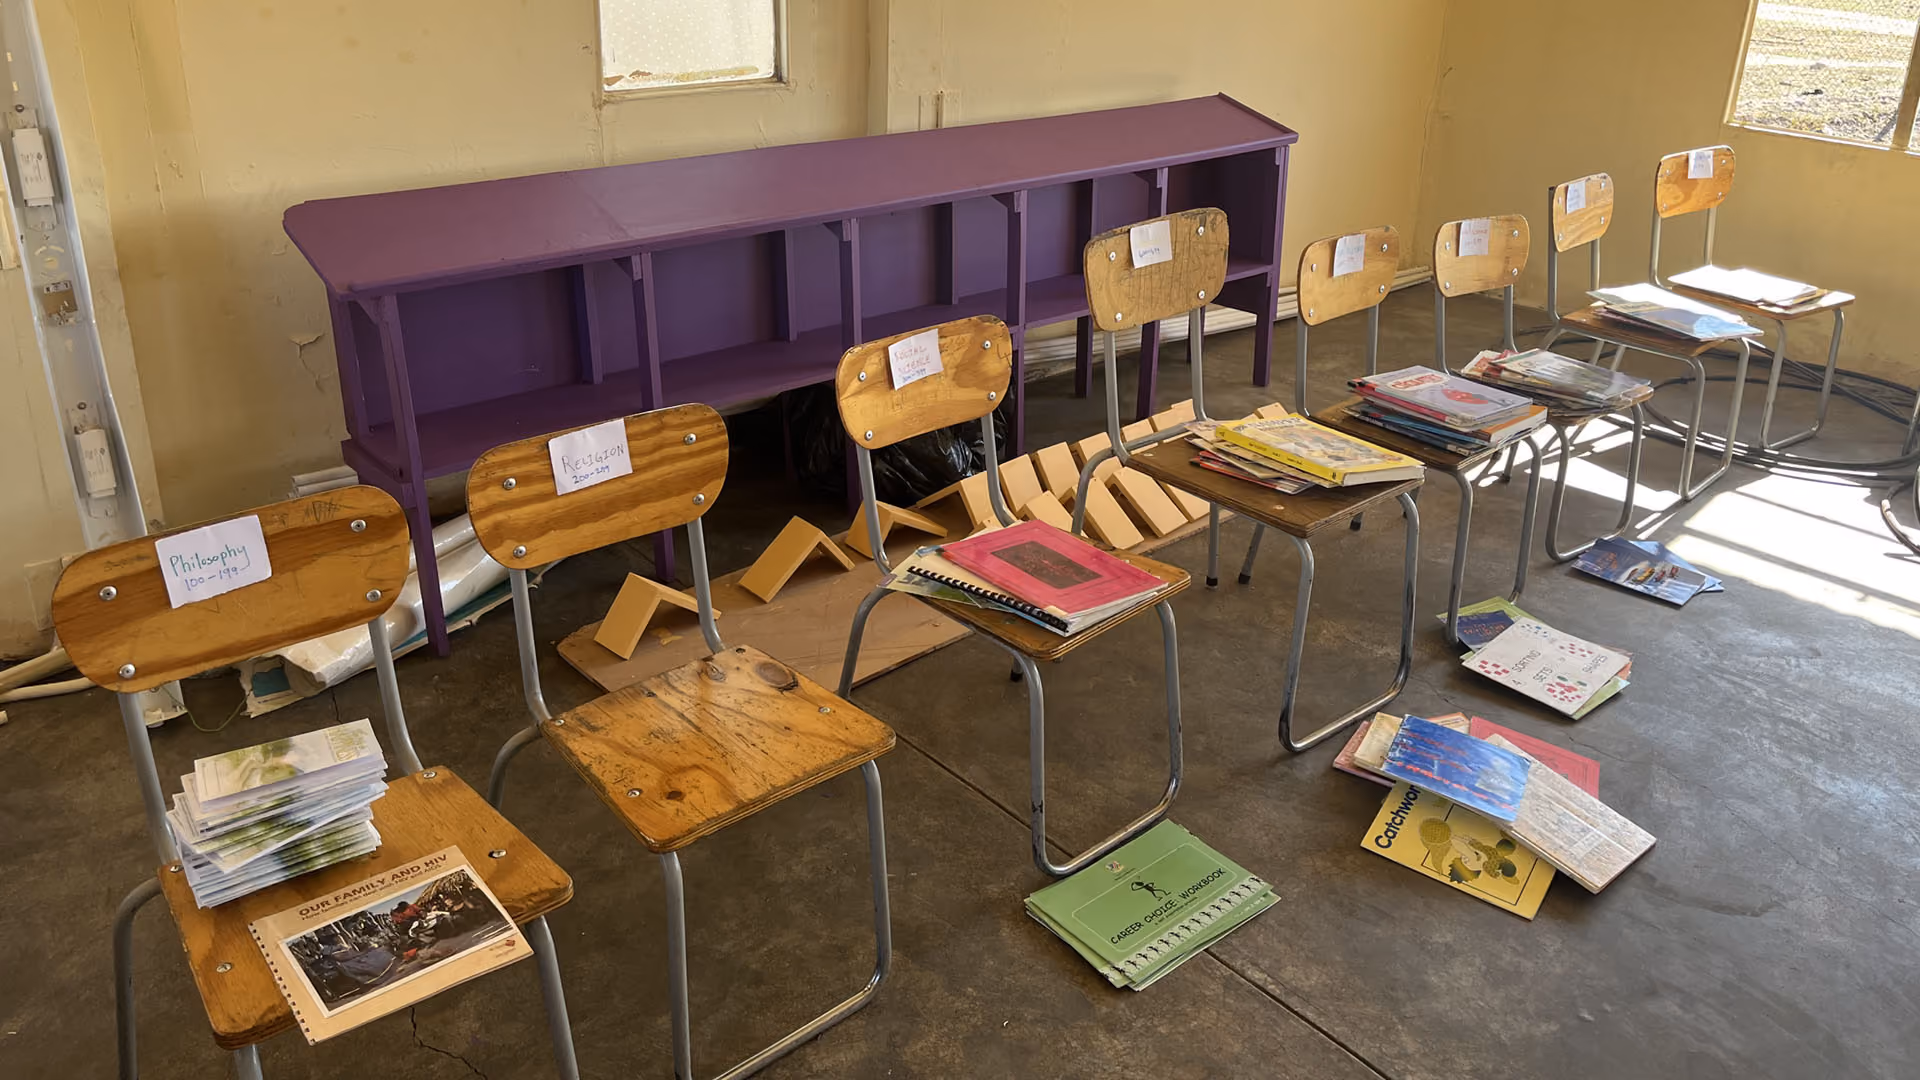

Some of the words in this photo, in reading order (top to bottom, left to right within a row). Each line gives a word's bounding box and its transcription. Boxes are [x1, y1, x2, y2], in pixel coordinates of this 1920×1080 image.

[561, 443, 625, 474] RELIGION
[169, 544, 251, 577] Philosophy
[298, 900, 331, 916] OUR
[334, 878, 386, 902] FAMILY
[391, 865, 421, 881] AND
[424, 854, 448, 866] HIV
[1110, 922, 1144, 944] CAREER
[1179, 867, 1227, 900] WORKBOOK
